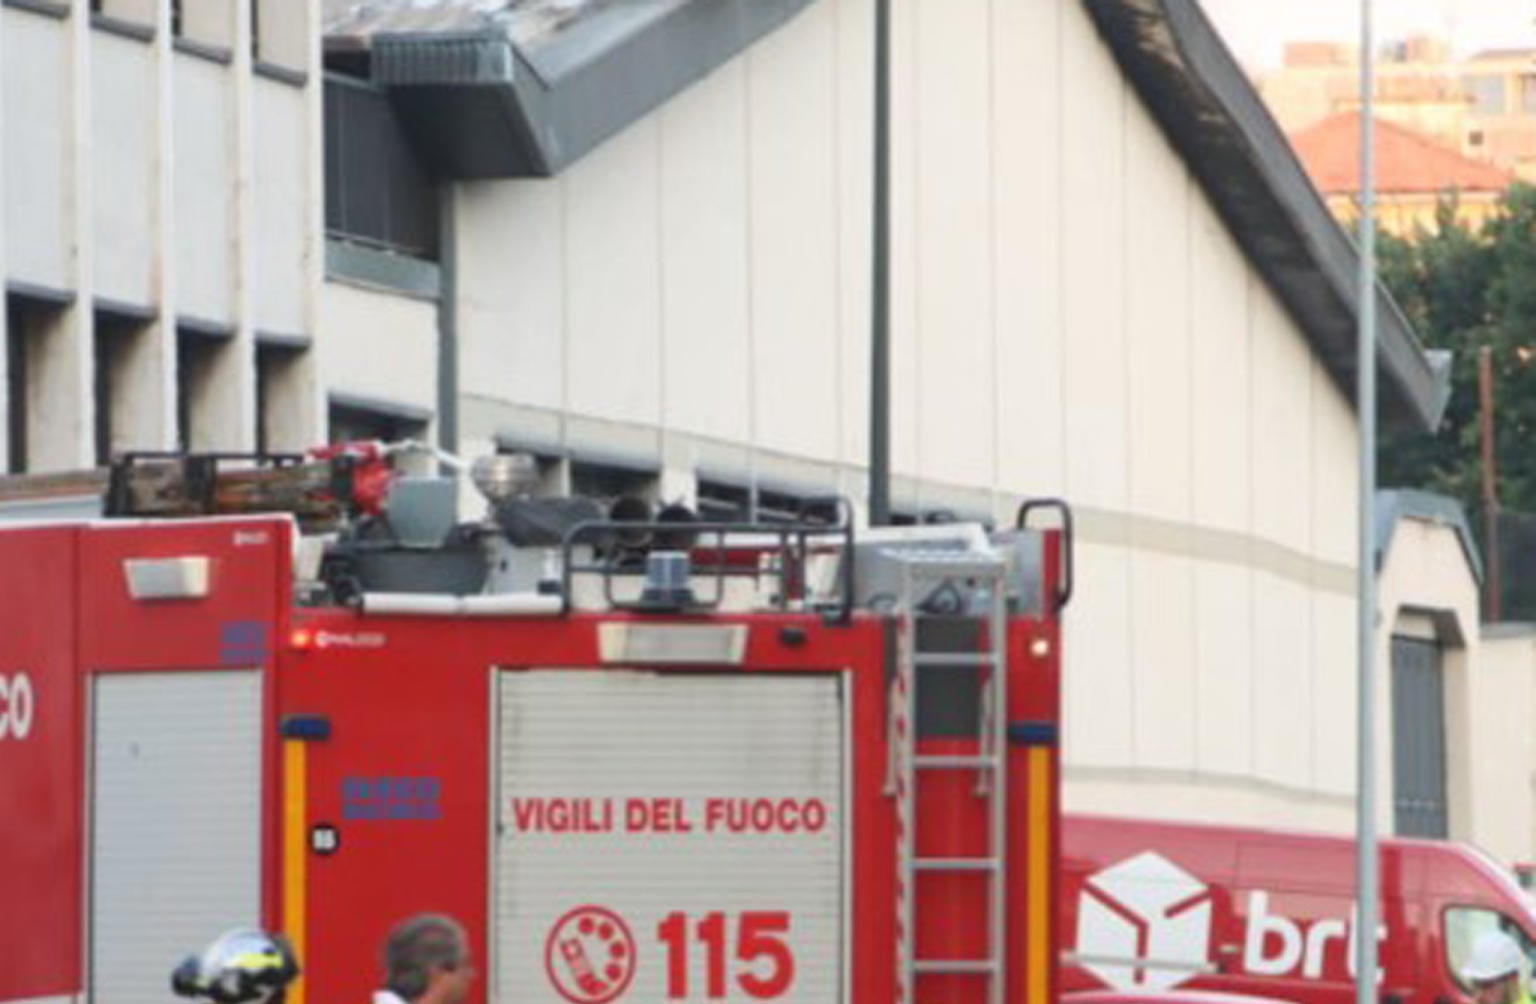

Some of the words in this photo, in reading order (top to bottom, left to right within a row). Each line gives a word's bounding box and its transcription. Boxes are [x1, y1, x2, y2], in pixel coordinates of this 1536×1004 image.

[512, 797, 613, 832] VIGILI
[625, 797, 692, 832] DEL
[705, 797, 826, 833] FUOCO
[657, 911, 795, 999] 115
